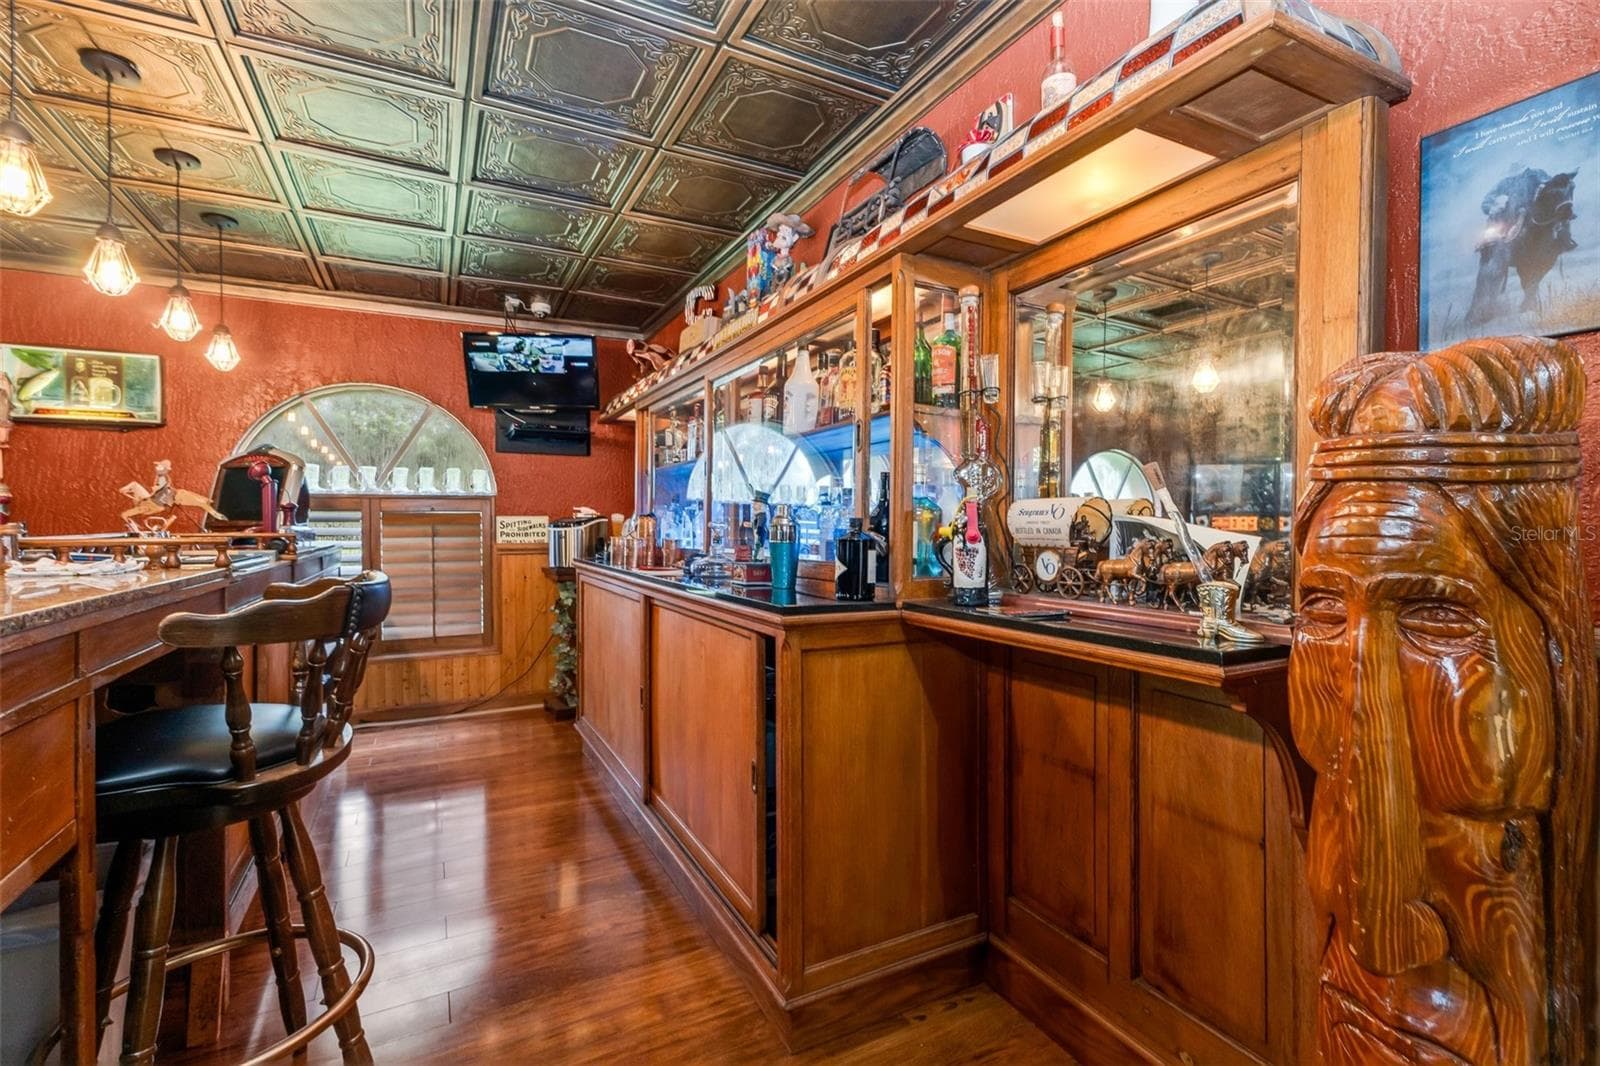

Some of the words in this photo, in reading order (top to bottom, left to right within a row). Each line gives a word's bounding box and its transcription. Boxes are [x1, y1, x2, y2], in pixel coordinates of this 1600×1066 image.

[1547, 101, 1563, 114] and
[1018, 508, 1049, 517] Seagram's
[1043, 527, 1062, 535] CANADA
